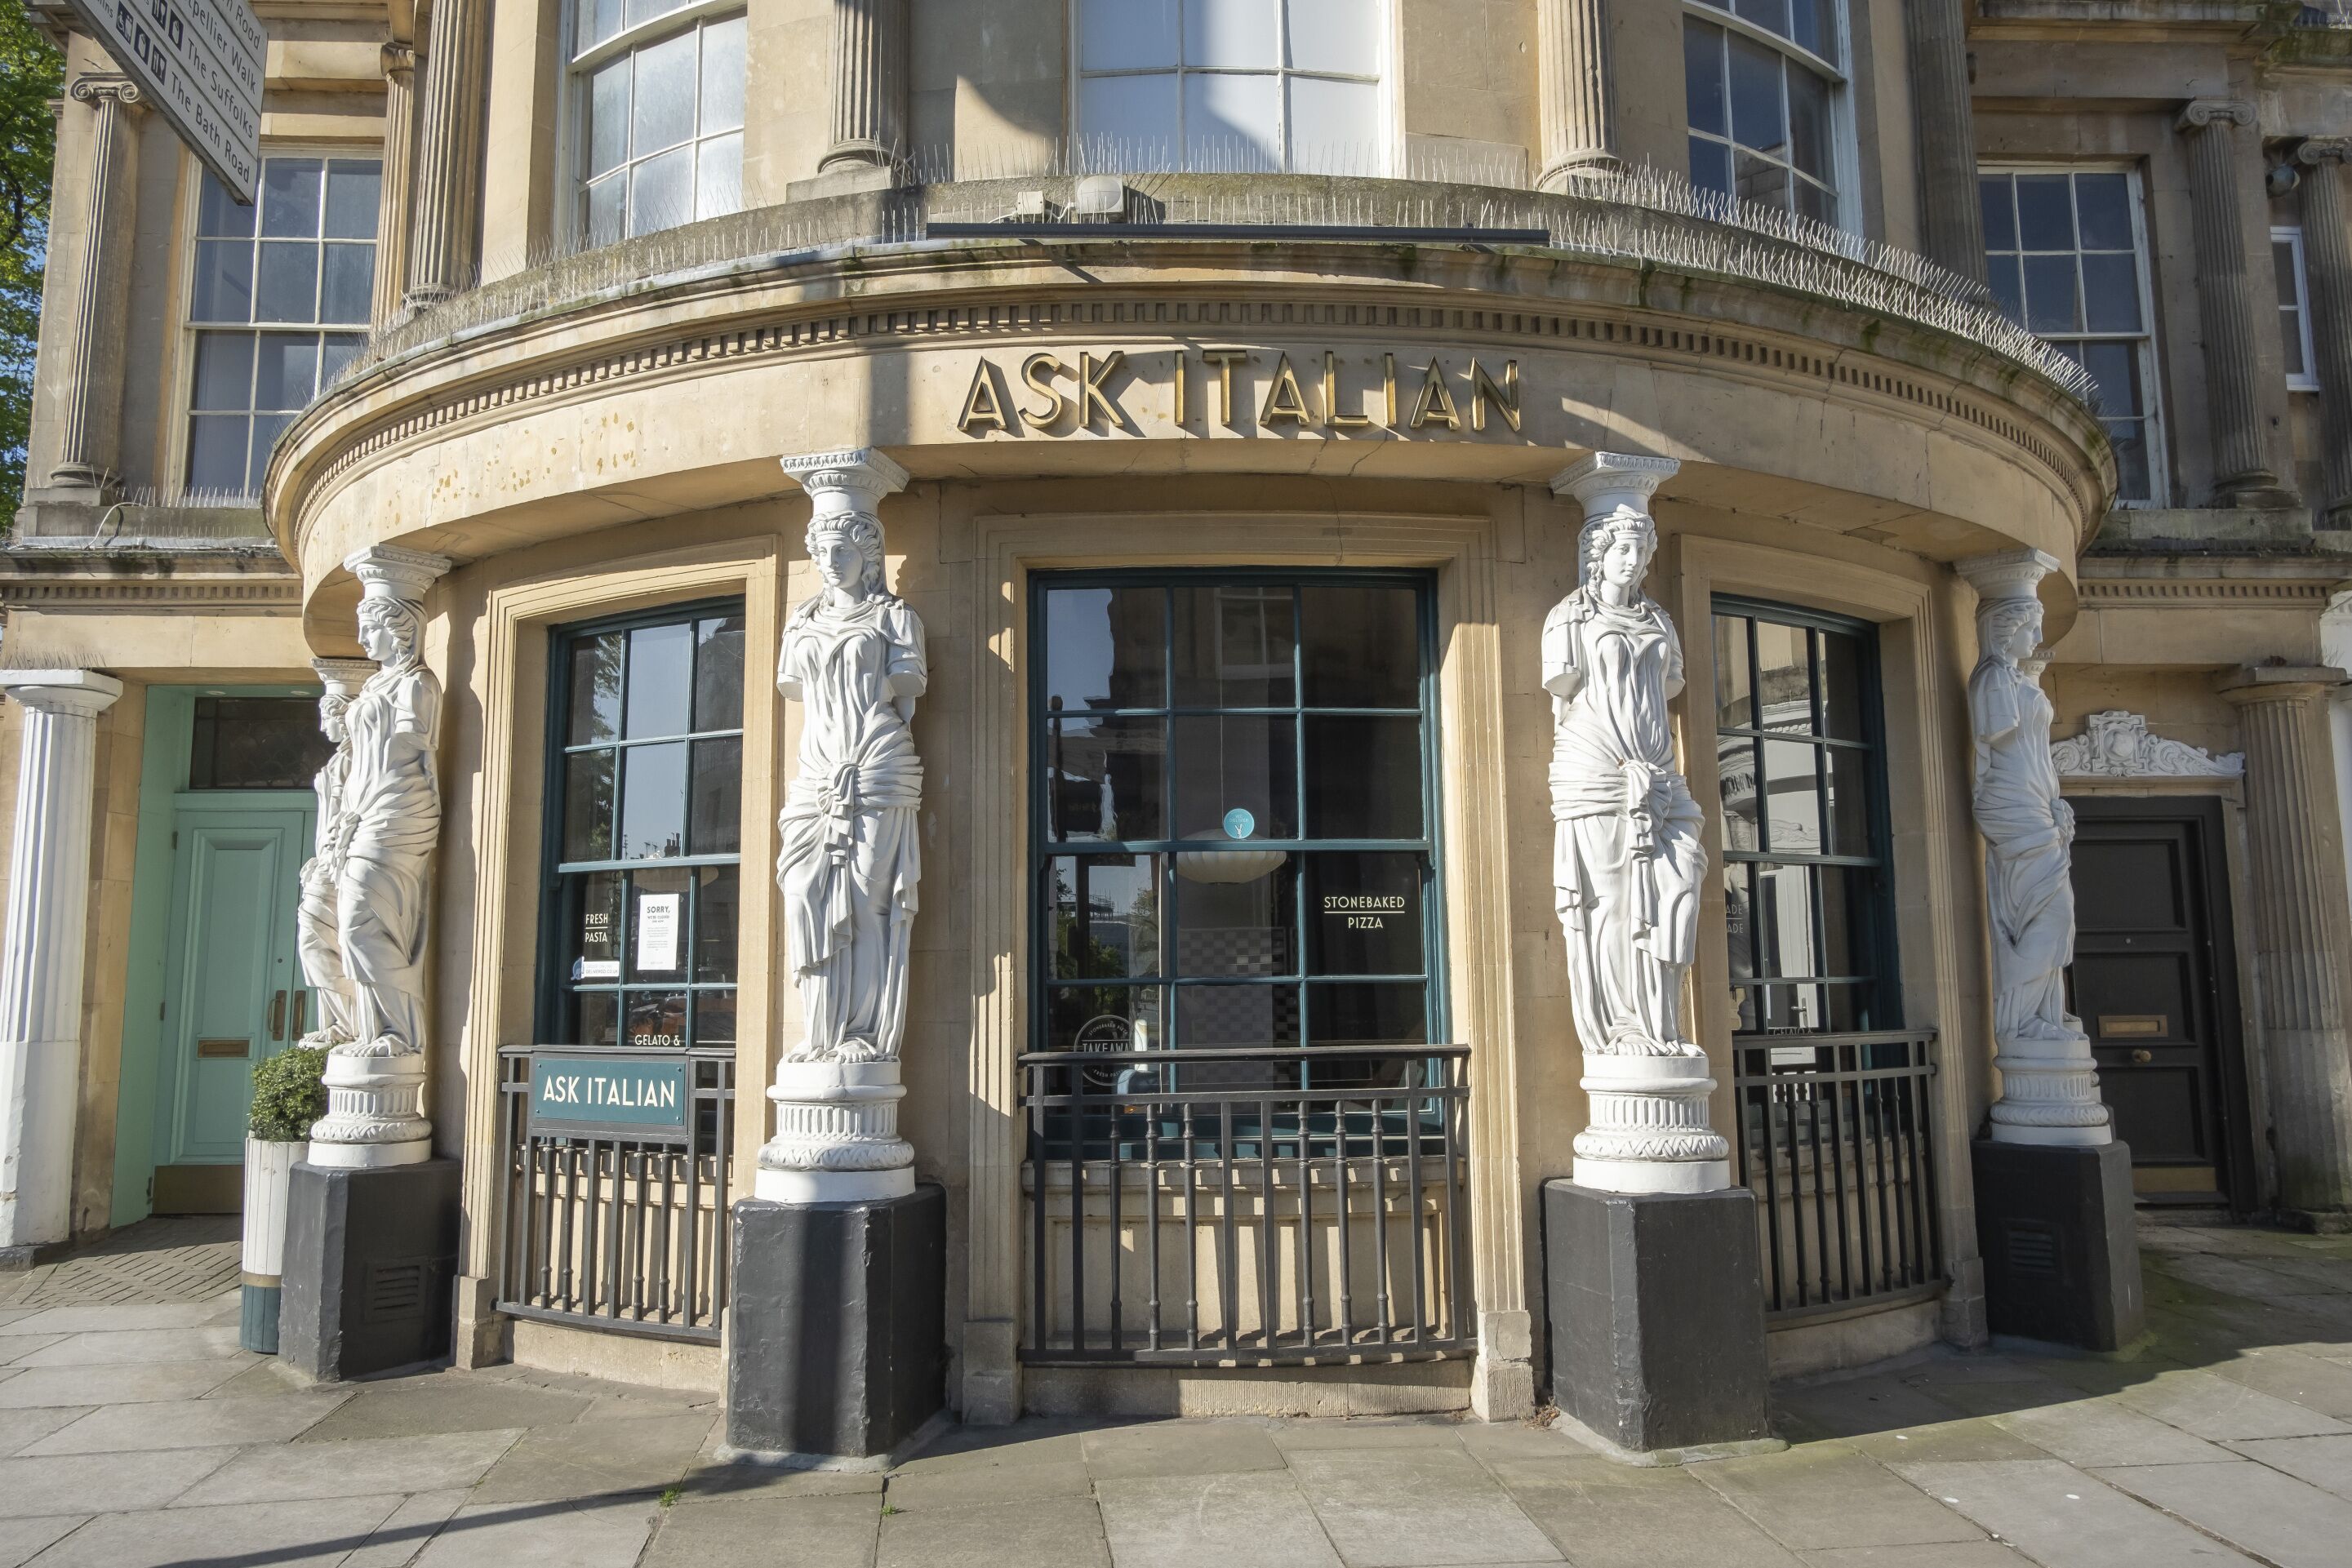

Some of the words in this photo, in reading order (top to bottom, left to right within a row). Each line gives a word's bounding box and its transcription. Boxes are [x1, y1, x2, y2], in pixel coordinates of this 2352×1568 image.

[235, 5, 260, 50] Road
[231, 45, 256, 96] Walk
[188, 38, 207, 79] The
[211, 70, 253, 139] Suffolks
[171, 72, 191, 113] The
[196, 103, 220, 149] Bath
[225, 140, 250, 184] Road
[957, 350, 1126, 431] ASK
[1173, 349, 1522, 433] ITALIAN
[1323, 895, 1406, 908] STONEBAKED
[585, 913, 608, 925] FRESH
[1347, 917, 1384, 929] PIZZA
[585, 932, 608, 943] PASTA
[634, 1034, 670, 1046] GELATO
[674, 1035, 680, 1046] &
[543, 1074, 580, 1104] ASK
[587, 1077, 676, 1108] ITALIAN
